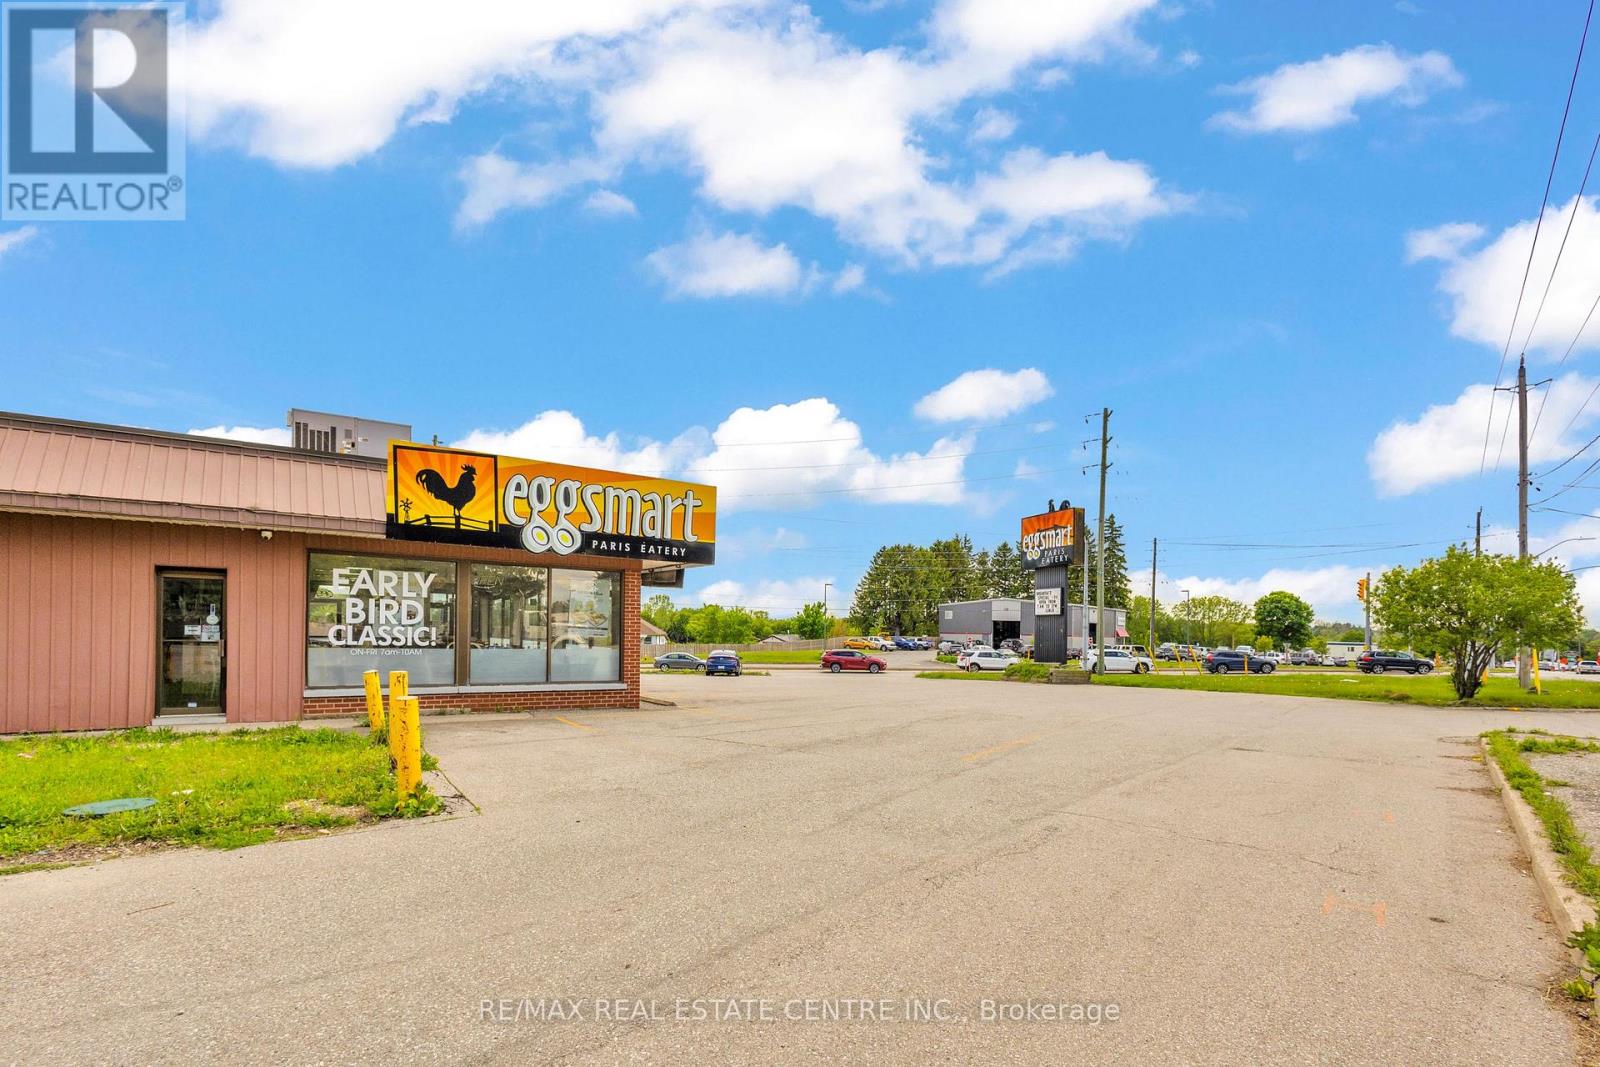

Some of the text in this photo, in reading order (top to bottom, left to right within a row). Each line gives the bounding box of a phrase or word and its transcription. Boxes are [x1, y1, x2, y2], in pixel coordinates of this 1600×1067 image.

[503, 474, 702, 556] eggsmart
[592, 540, 687, 557] PARIS EATERY
[1023, 524, 1073, 560] eggsmart
[1044, 548, 1065, 557] PARIS
[1041, 555, 1068, 565] EATERY
[332, 568, 438, 598] EARLY
[345, 597, 424, 625] BIRD
[327, 624, 437, 647] CLASSIC!
